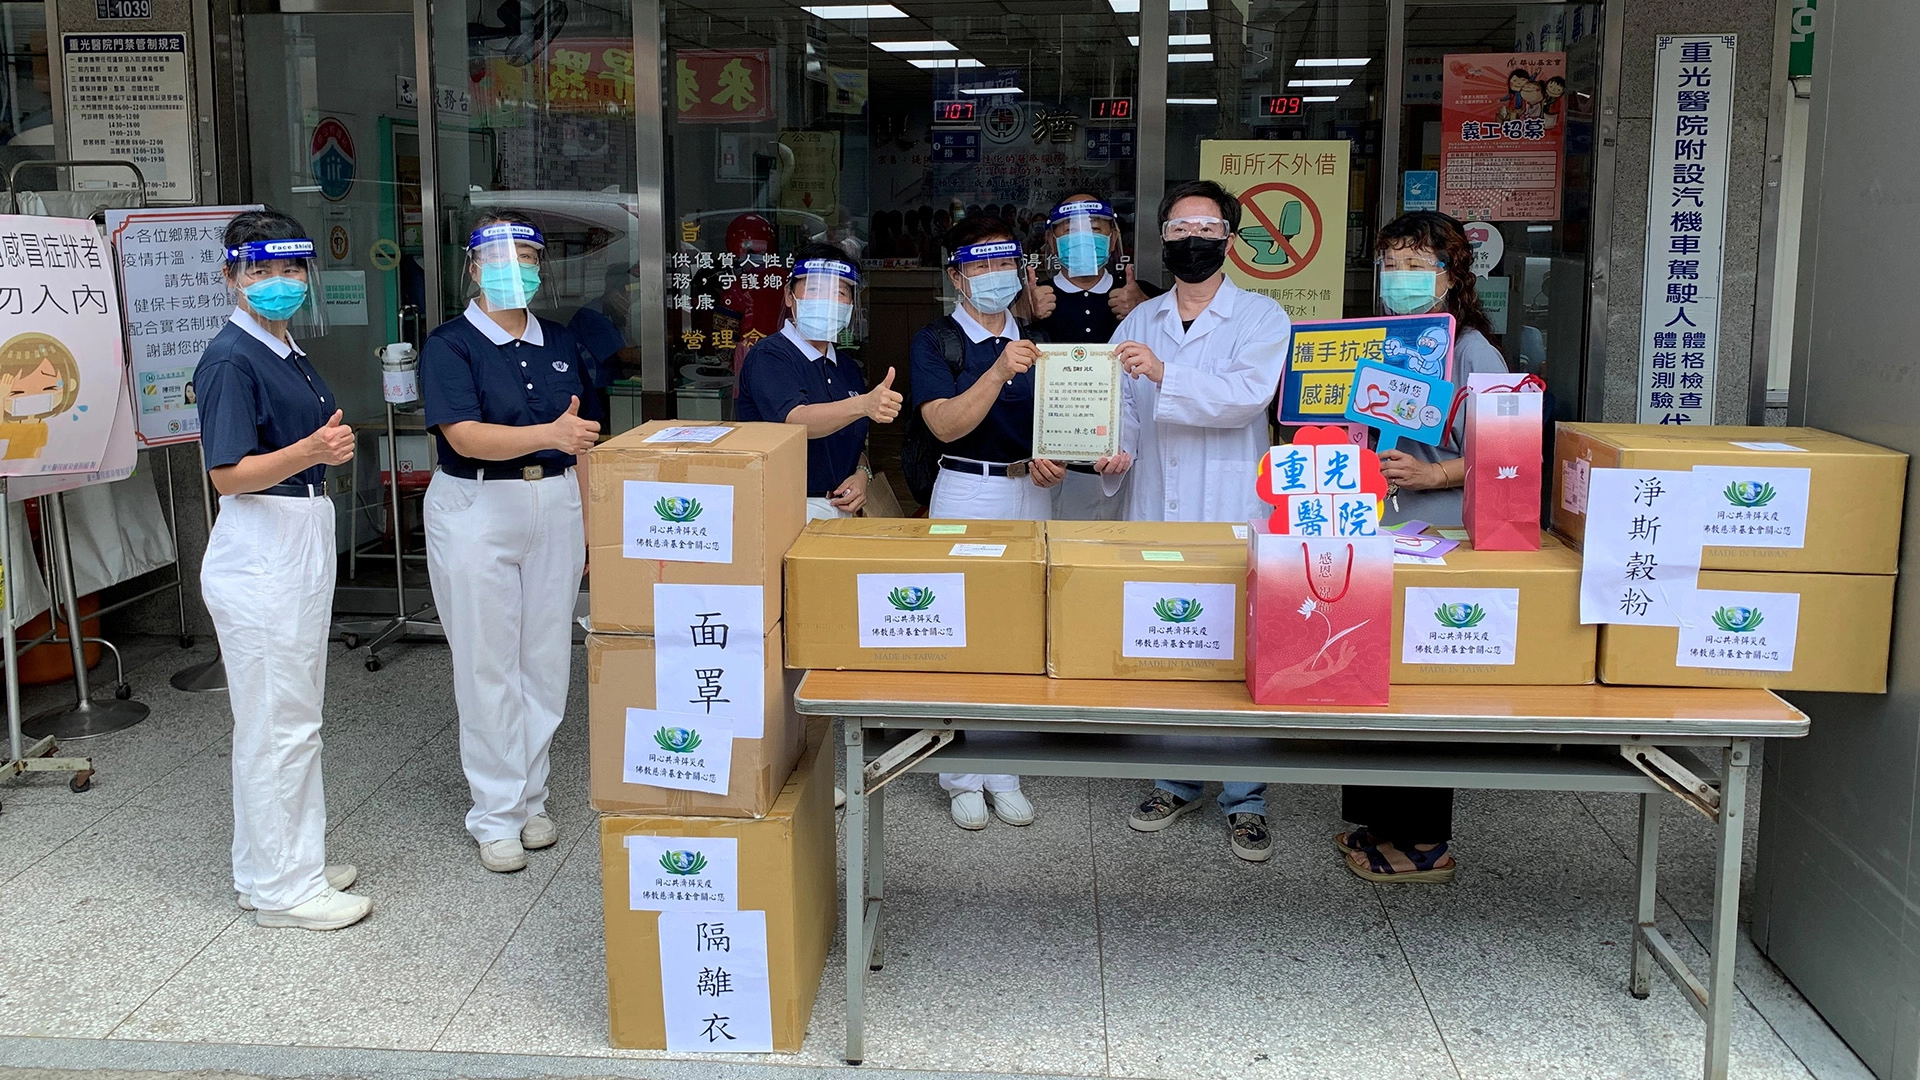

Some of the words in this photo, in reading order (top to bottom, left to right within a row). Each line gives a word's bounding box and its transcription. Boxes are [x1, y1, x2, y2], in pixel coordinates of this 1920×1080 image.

[115, 1, 149, 17] 1039
[69, 38, 181, 51] 重光醫院門禁管制規定
[943, 104, 972, 119] 107
[1100, 101, 1129, 117] 110
[1269, 98, 1300, 114] 109
[1461, 119, 1545, 141] 義工招募
[1219, 152, 1337, 176] 廁所不外借
[1665, 41, 1713, 328] 重光醫院附設汽機車駕駛人
[0, 233, 103, 269] 感冒症狀者
[1293, 338, 1384, 364] 攜手抗疫
[1650, 331, 1677, 409] 體能測驗
[1679, 331, 1705, 409] 體格檢查
[1301, 382, 1352, 406] 感謝
[1274, 449, 1358, 491] 重光
[1293, 498, 1377, 537] 醫院
[636, 538, 720, 551] 佛教慈濟基金會關心您
[1619, 476, 1666, 617] 淨斯穀粉
[871, 627, 954, 637] 佛教慈濟基金會關心您
[1134, 639, 1221, 650] 佛教慈濟基金會關心您
[1415, 645, 1502, 655] 佛教慈濟基金會關心您
[874, 653, 899, 661] MADE
[913, 653, 948, 661] TAIWAN
[1690, 648, 1779, 660] 佛教慈濟基金會關心您
[689, 612, 731, 715] 面罩
[1138, 660, 1165, 668] MADE
[1168, 660, 1177, 668] IN
[1179, 660, 1215, 669] TAIWAN
[1419, 665, 1446, 674] MADE
[1461, 665, 1497, 674] TAIWAN
[635, 765, 717, 783] 佛教慈濟基金會關心您
[642, 890, 725, 902] 佛教慈濟基金會關心您
[695, 921, 738, 1043] 隔離衣
